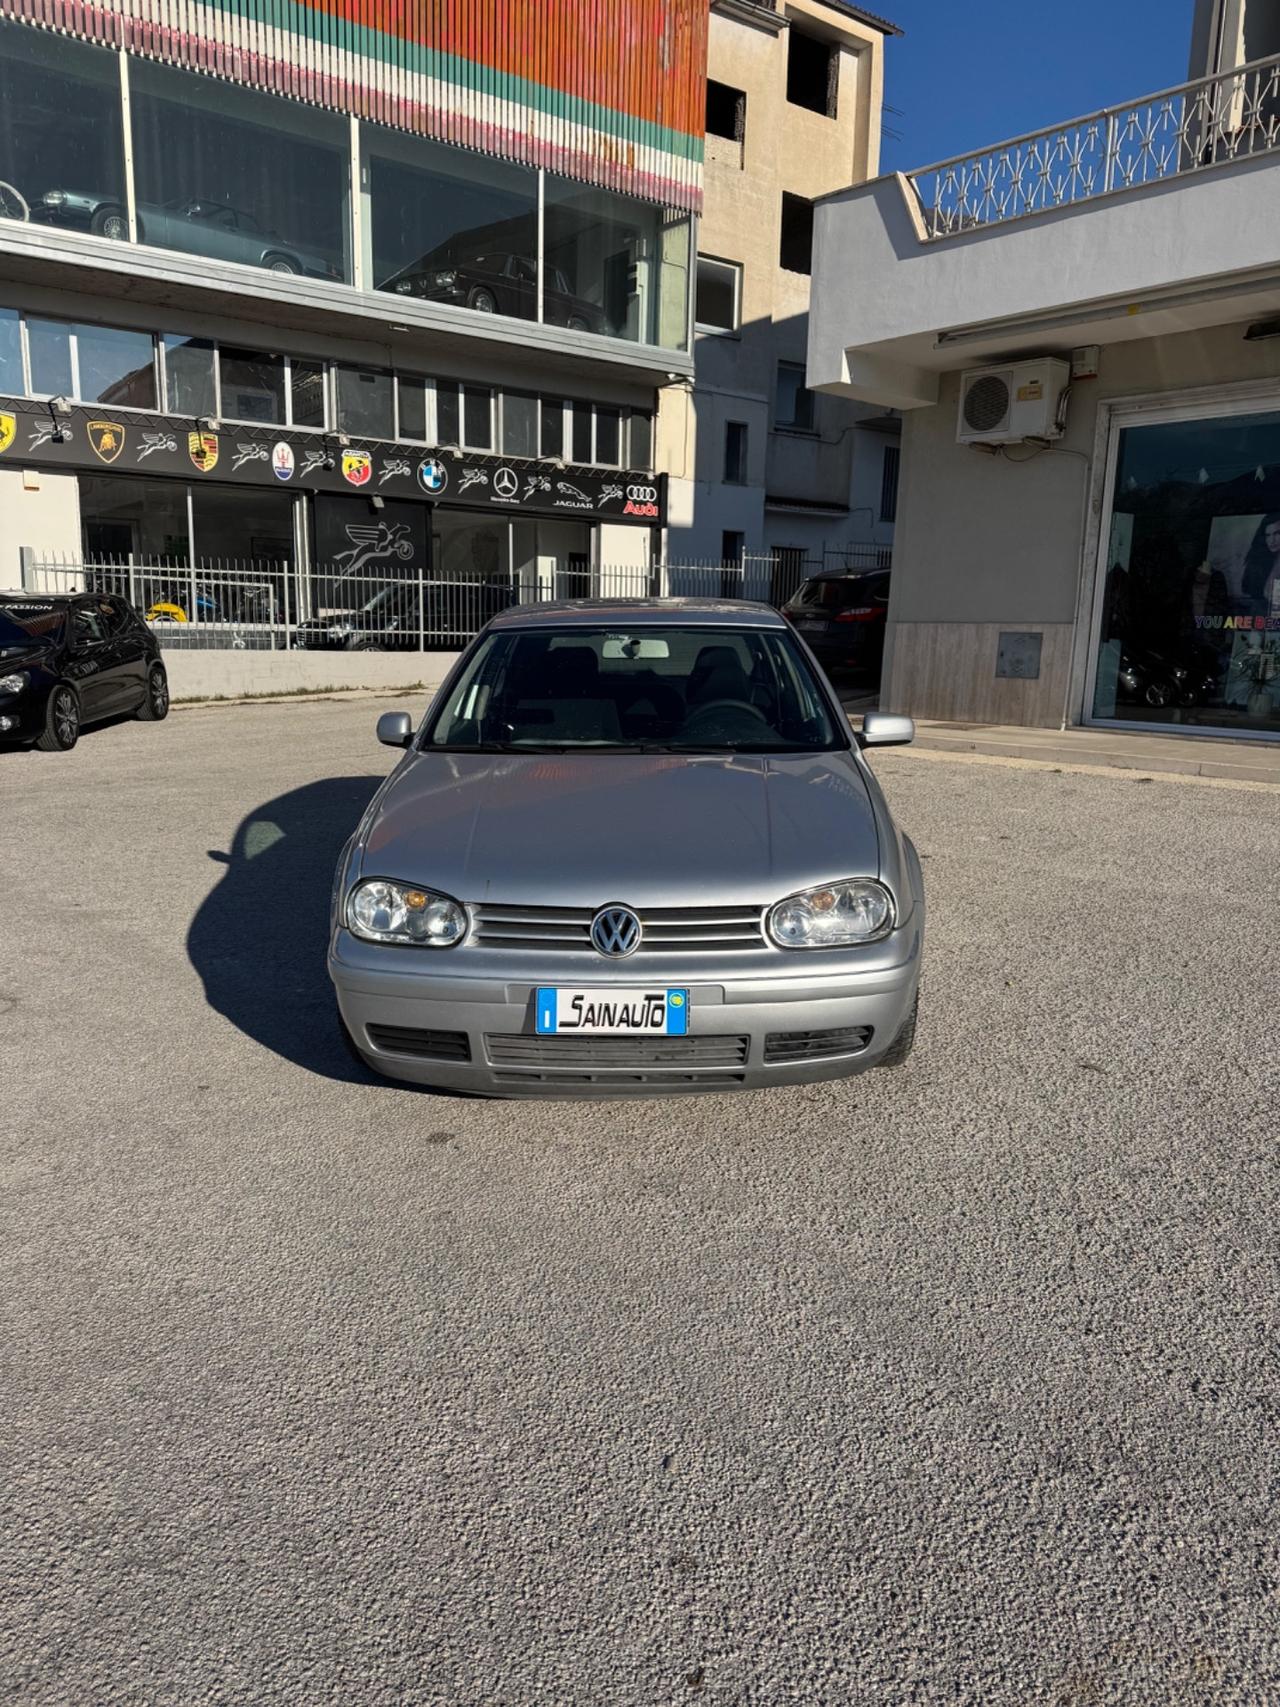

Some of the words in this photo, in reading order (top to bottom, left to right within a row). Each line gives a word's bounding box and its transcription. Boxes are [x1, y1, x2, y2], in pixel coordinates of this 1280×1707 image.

[552, 500, 594, 510] JAGUAR
[623, 501, 658, 516] Audi
[1194, 615, 1223, 629] YOU
[1223, 615, 1252, 629] ARE
